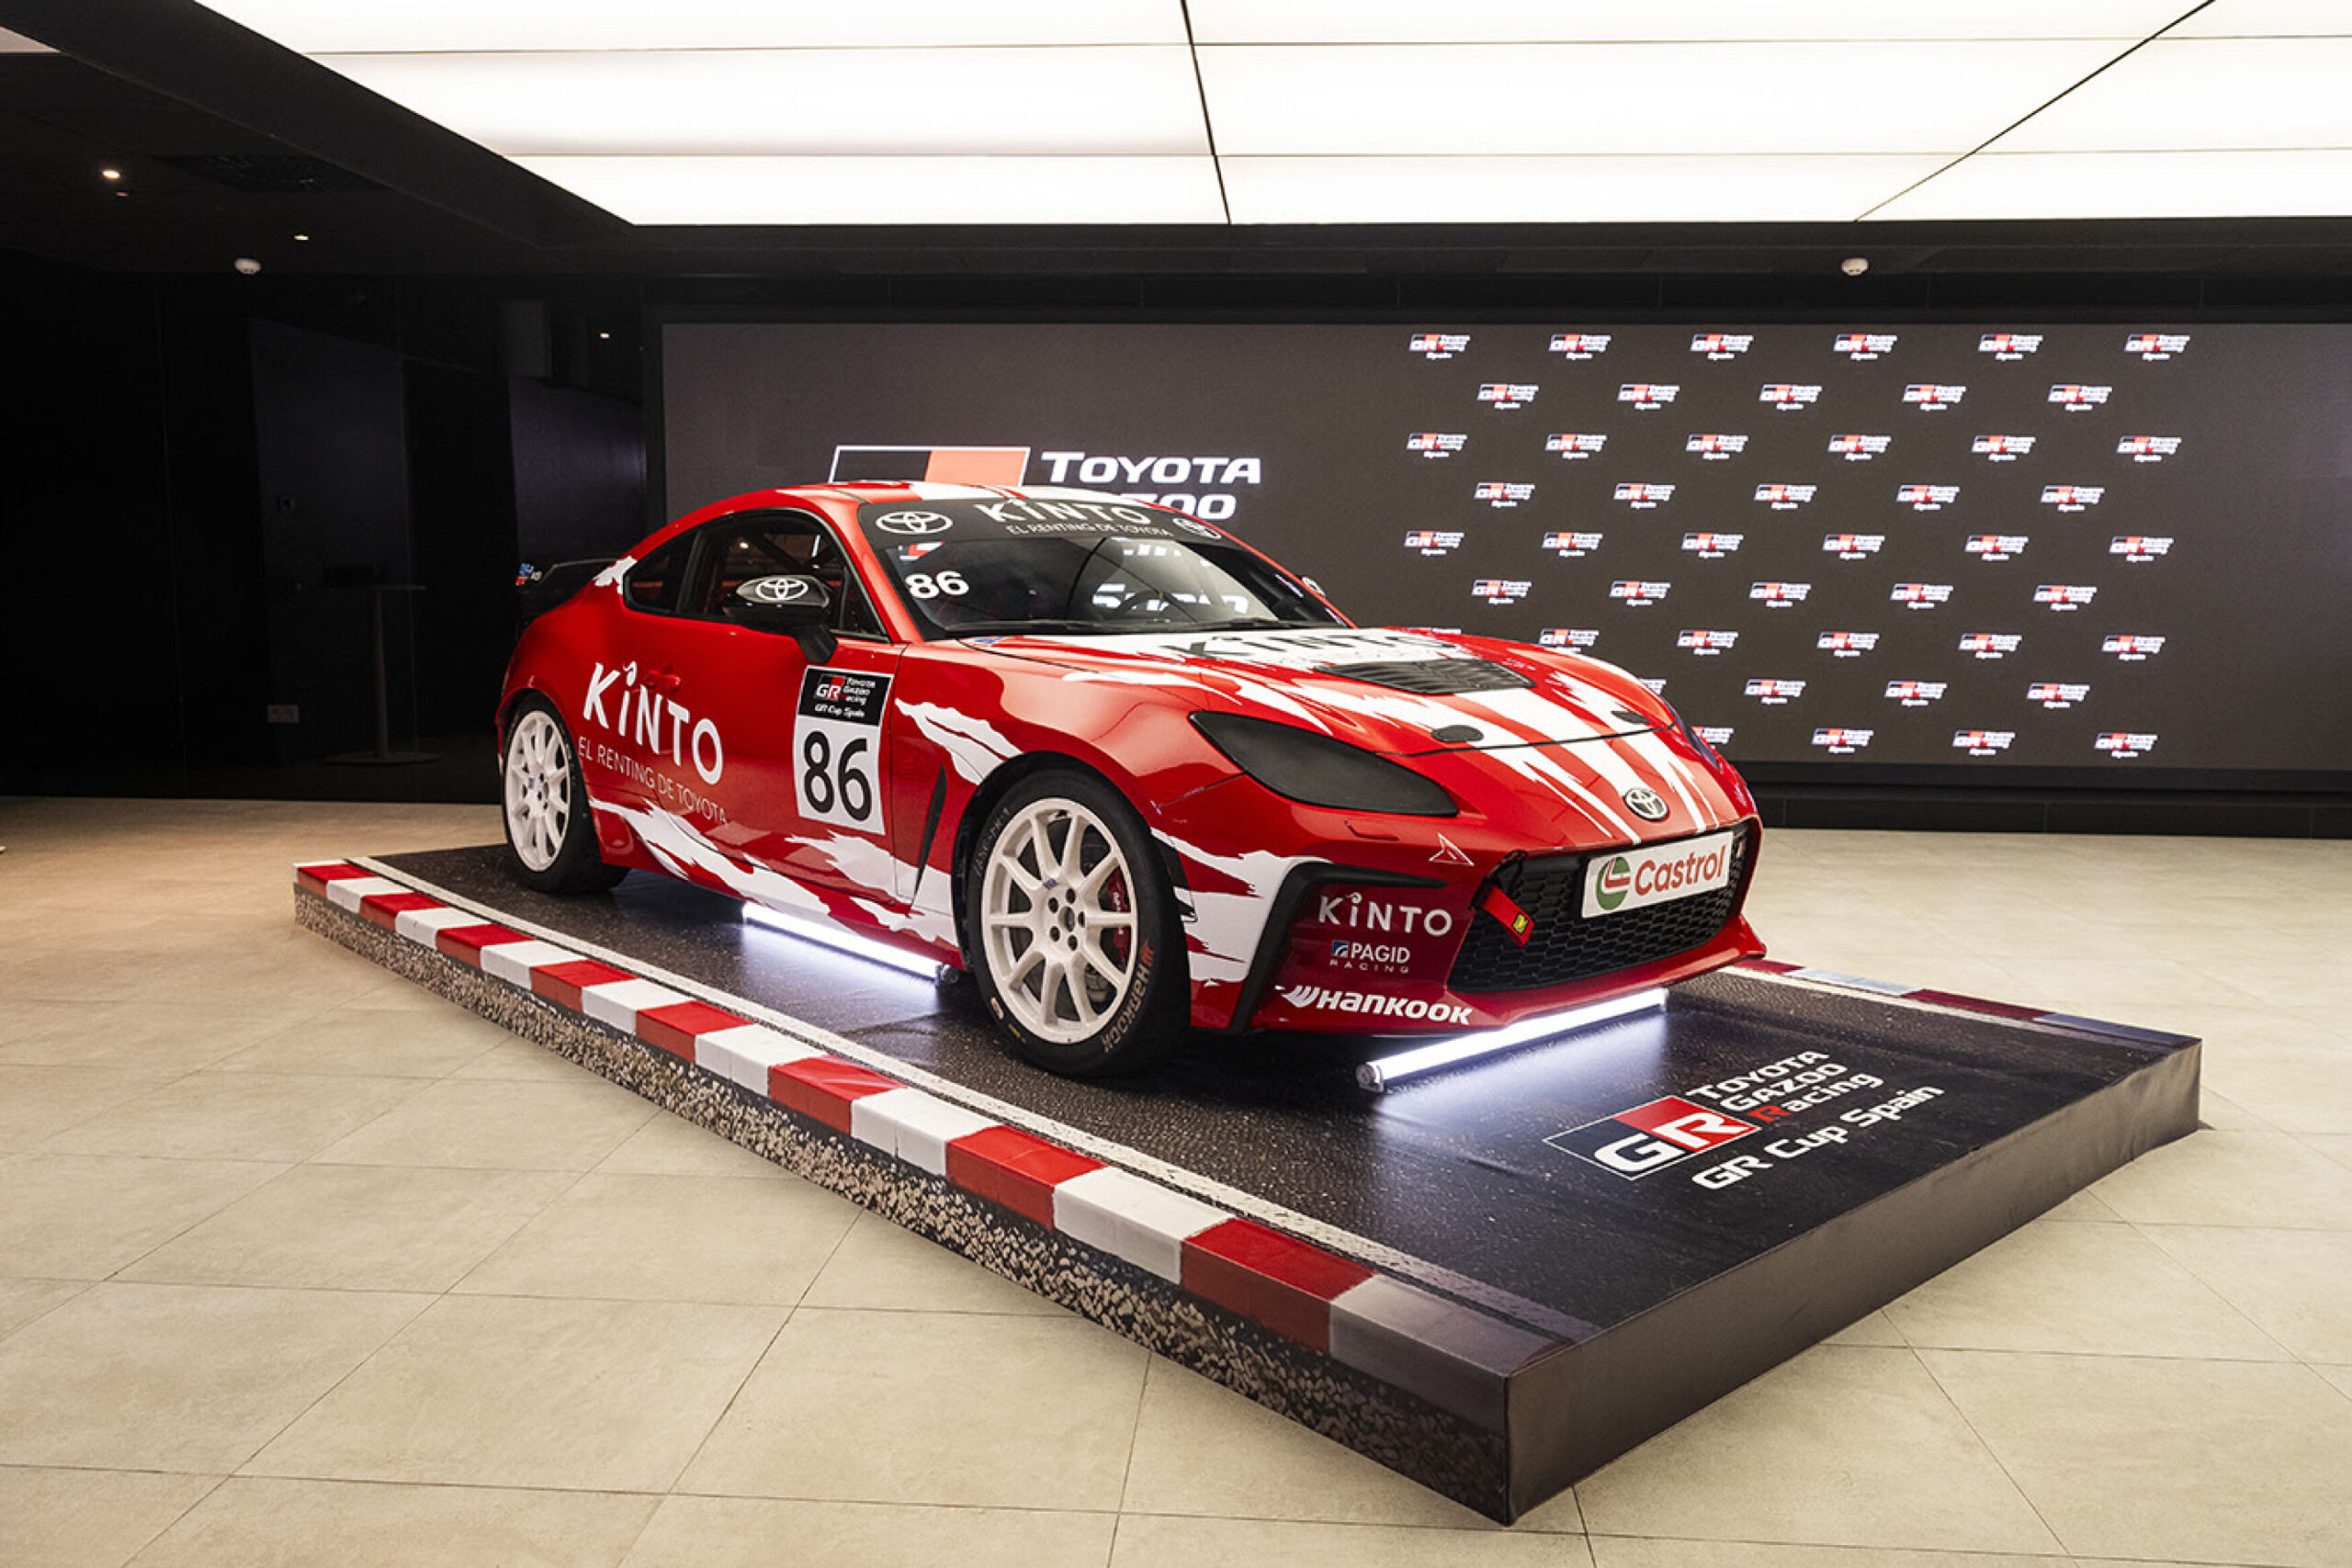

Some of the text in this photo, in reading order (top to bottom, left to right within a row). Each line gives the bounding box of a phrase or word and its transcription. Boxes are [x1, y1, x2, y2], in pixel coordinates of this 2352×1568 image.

[1041, 451, 1261, 484] TOYOTA
[905, 571, 969, 599] 86
[816, 684, 841, 698] GR
[578, 736, 728, 826] EL RENTING DE TOYOTA
[804, 730, 872, 822] 86
[1635, 844, 1725, 896] Castrol
[1329, 960, 1409, 974] RACING
[1351, 942, 1410, 964] PAGID
[1686, 1050, 1830, 1100] TOYOTA
[1720, 1063, 1849, 1112] GAZOO
[1747, 1073, 1884, 1122] Racing
[1594, 1112, 1751, 1172] GR
[1691, 1086, 1945, 1190] GR Cup Spain
